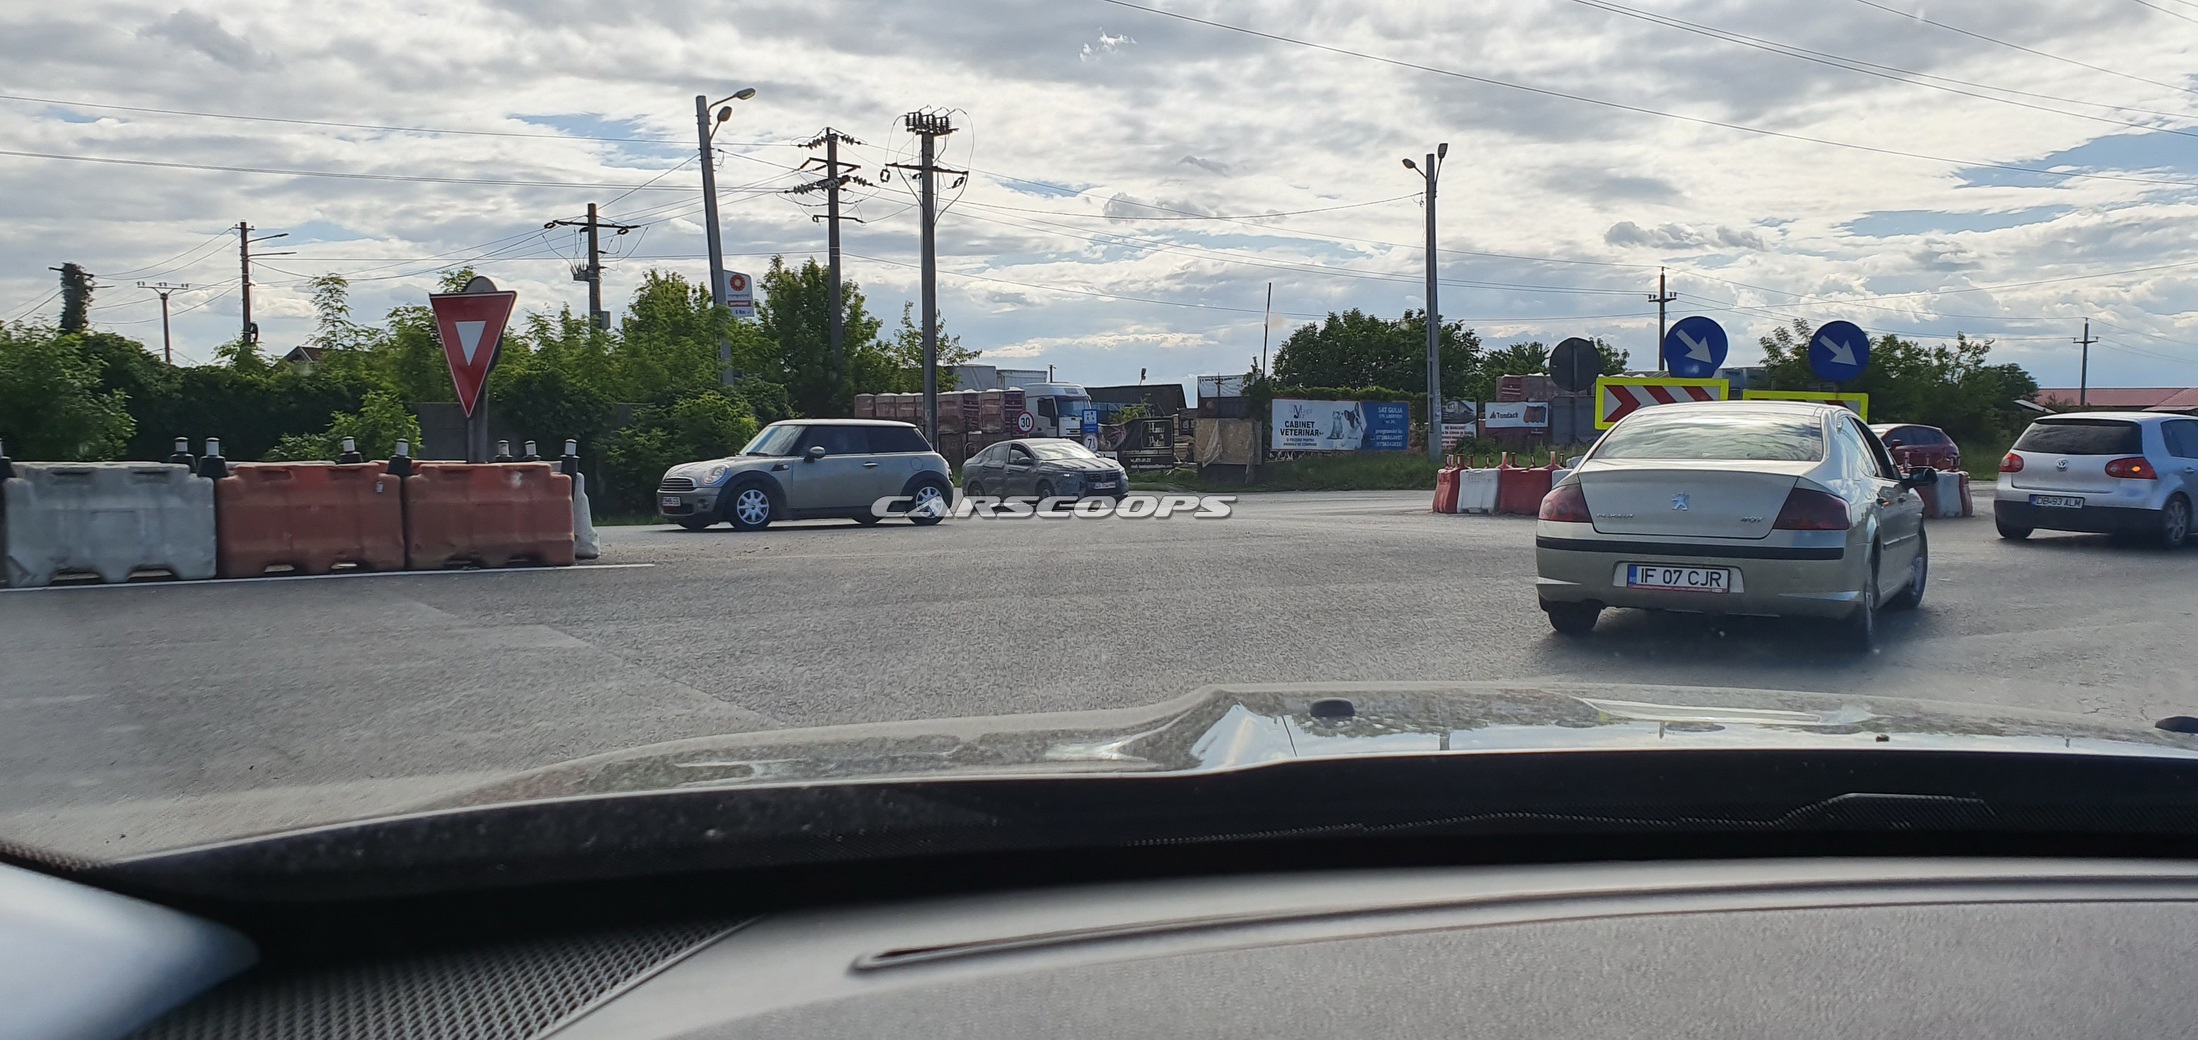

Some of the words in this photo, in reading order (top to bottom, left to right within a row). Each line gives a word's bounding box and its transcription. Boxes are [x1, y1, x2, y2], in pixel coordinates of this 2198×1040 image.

[1496, 411, 1519, 419] Tondach
[1020, 417, 1031, 428] 30
[1284, 420, 1315, 428] CABINET
[1280, 428, 1320, 437] VETERINAR
[2064, 498, 2082, 508] ALM
[1640, 568, 1657, 583] IF
[1662, 569, 1683, 585] 07
[1687, 570, 1722, 587] CJR
